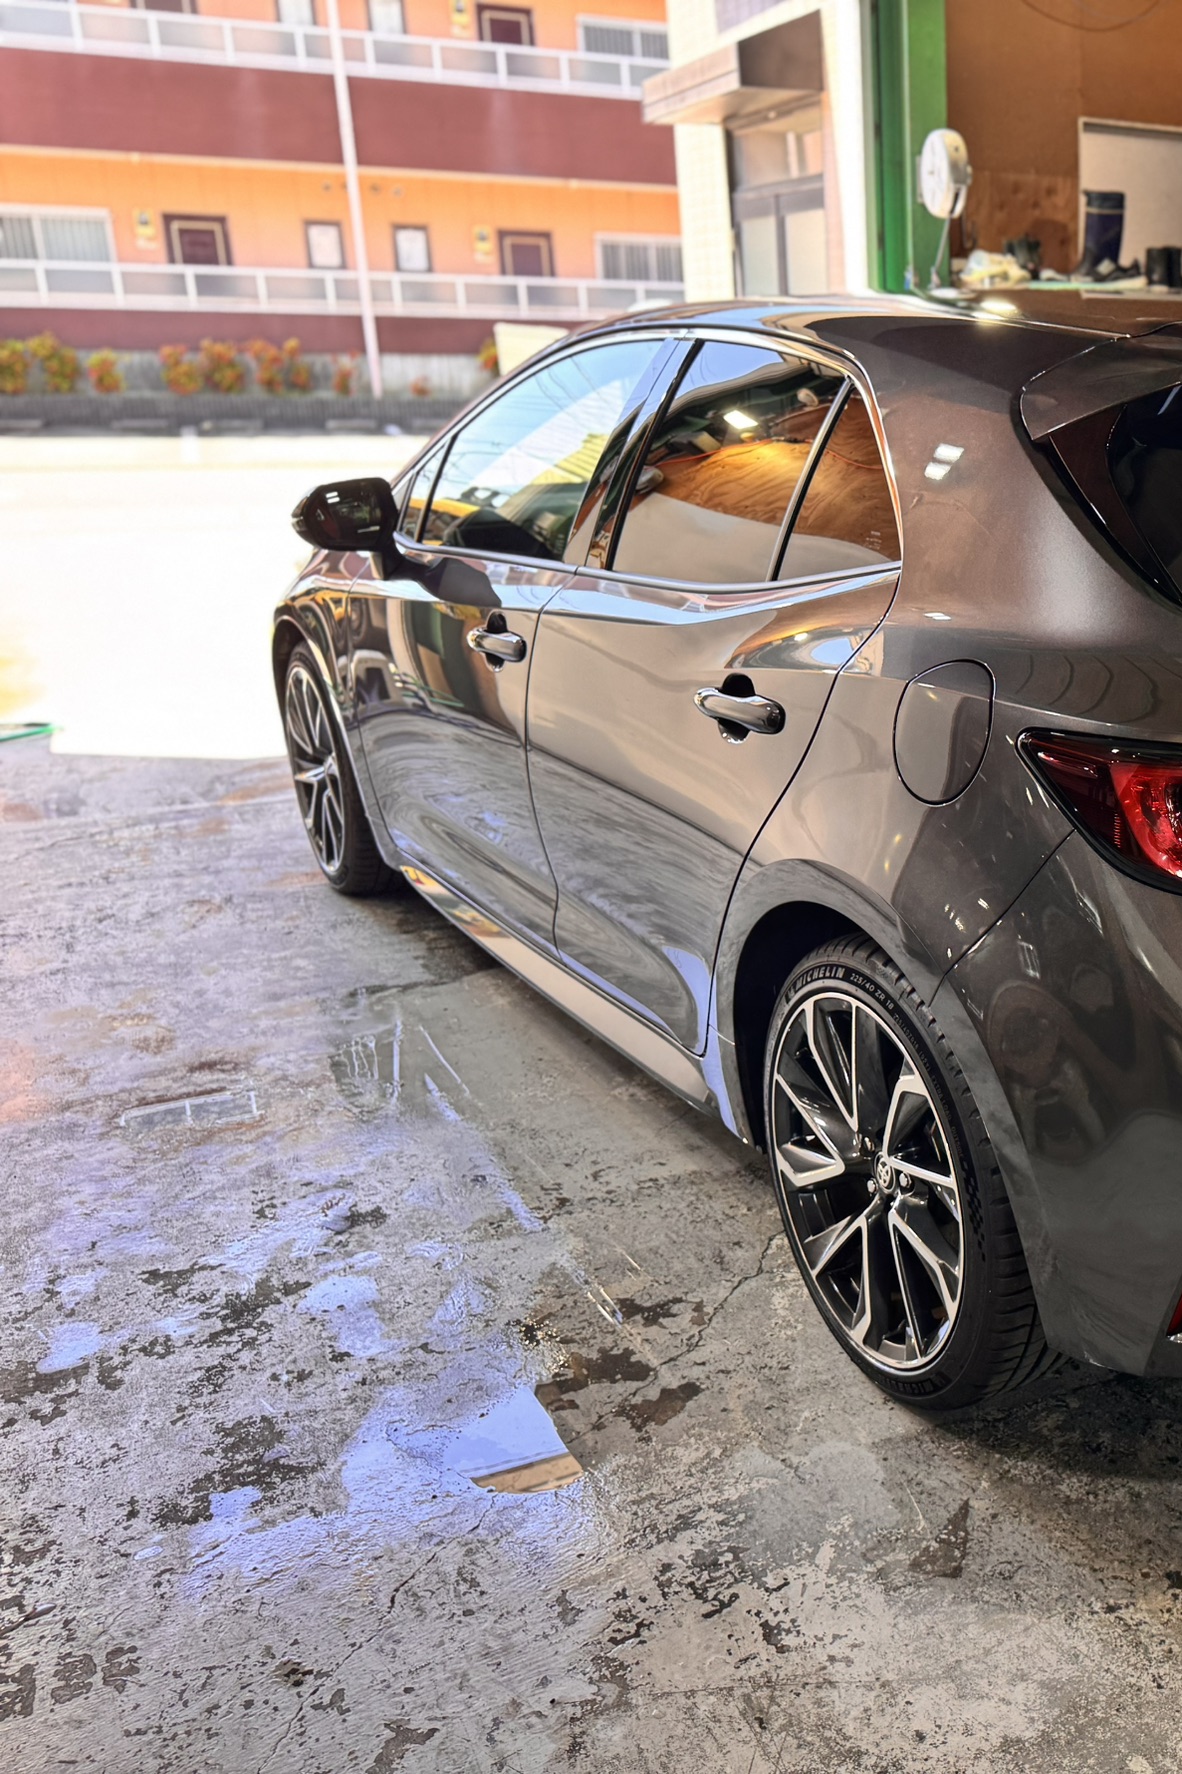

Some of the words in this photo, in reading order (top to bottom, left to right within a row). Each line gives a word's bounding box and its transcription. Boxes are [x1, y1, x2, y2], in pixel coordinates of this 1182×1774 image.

[796, 966, 845, 990] MICHELIN
[850, 973, 875, 992] 225/40
[875, 989, 886, 1001] ZR
[885, 1000, 895, 1010] 18
